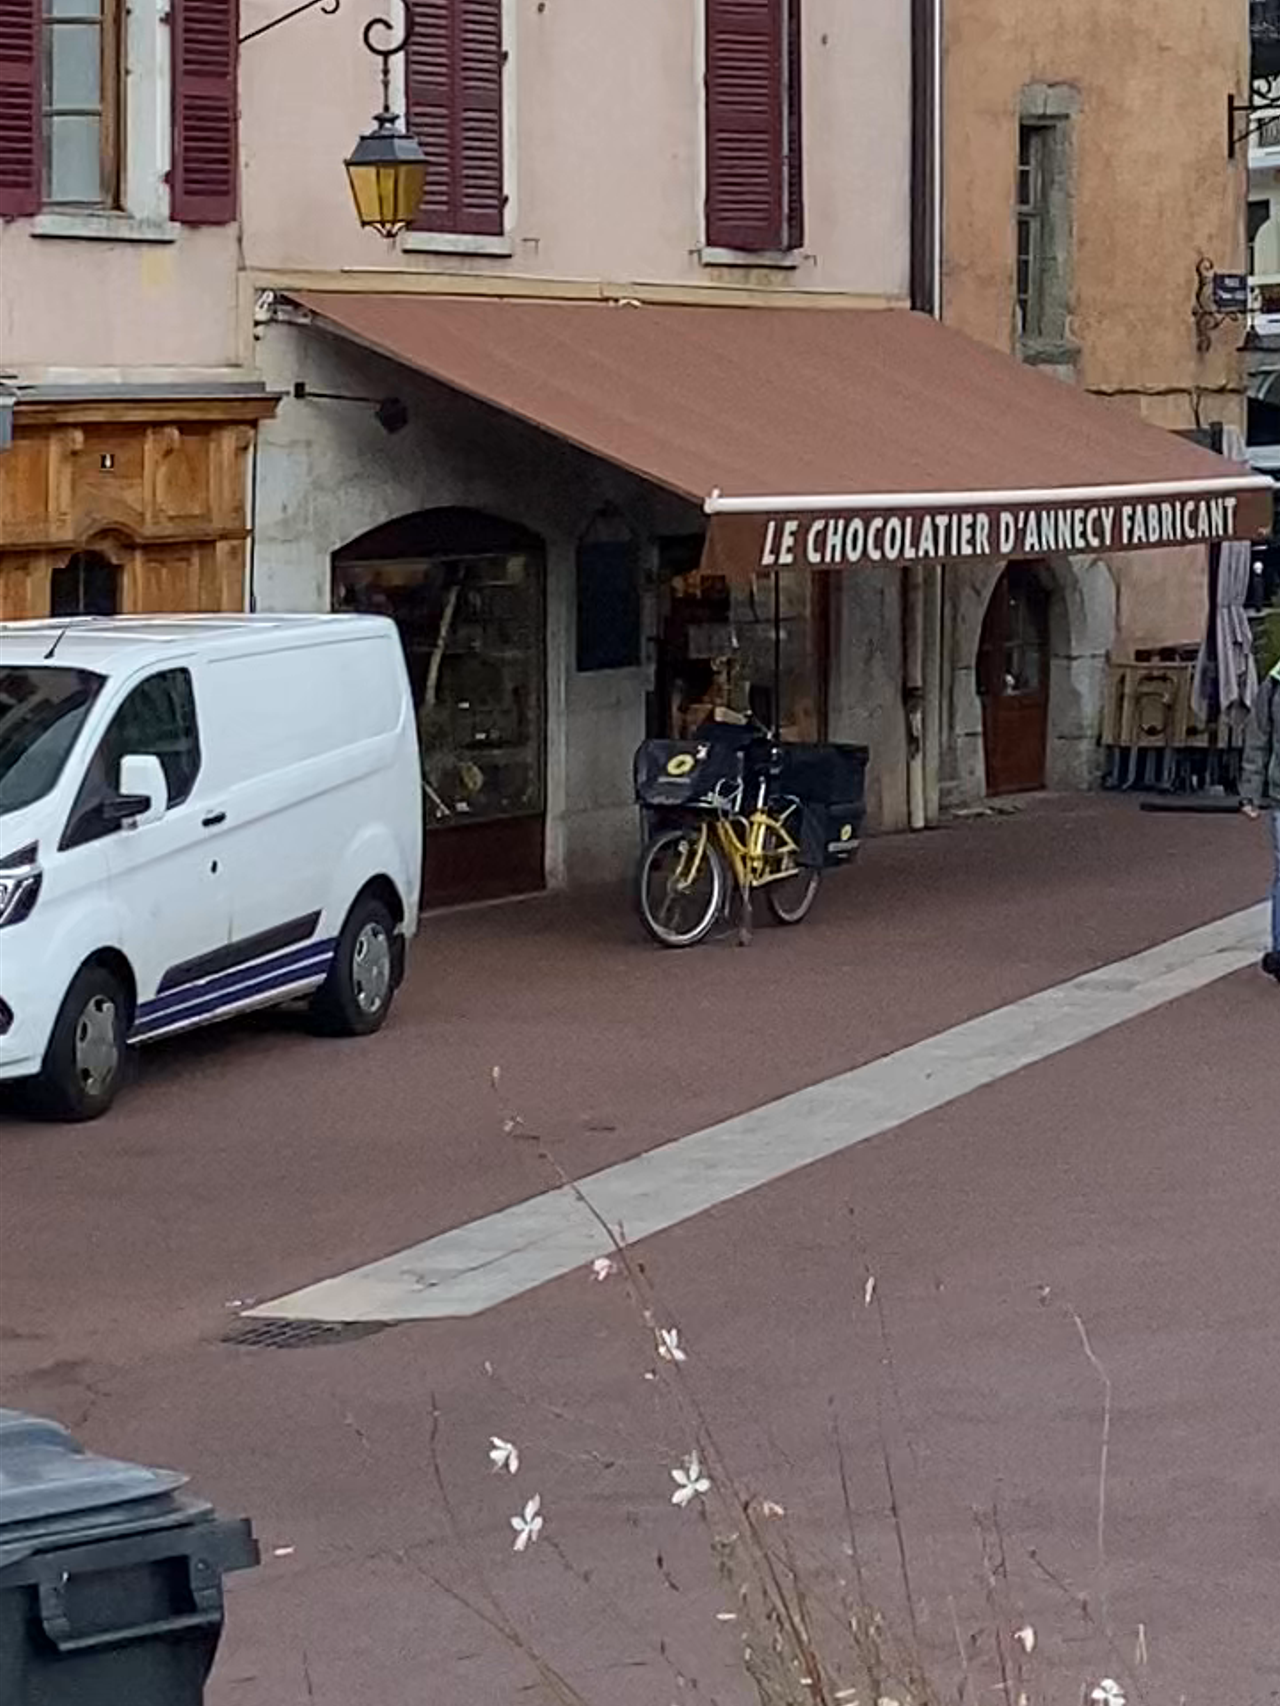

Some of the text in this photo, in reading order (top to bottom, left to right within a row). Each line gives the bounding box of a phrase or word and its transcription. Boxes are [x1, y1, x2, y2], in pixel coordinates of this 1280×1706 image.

[761, 497, 1238, 566] LE CHOCOLATIER D'ANNECY FABRICANT
